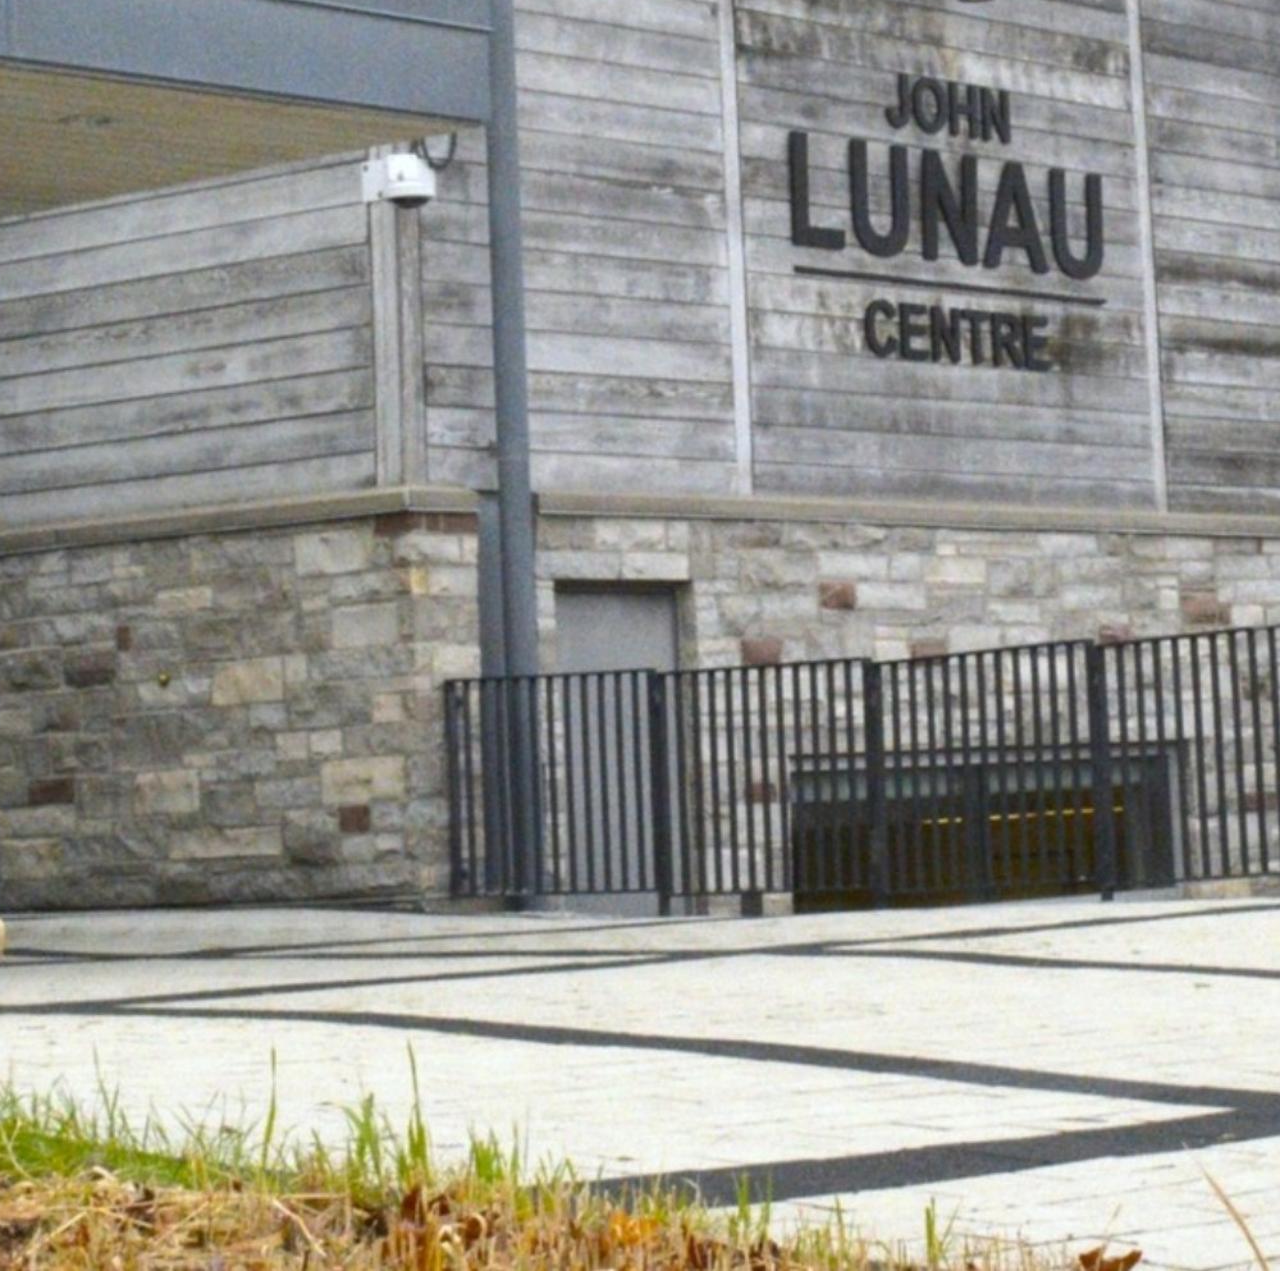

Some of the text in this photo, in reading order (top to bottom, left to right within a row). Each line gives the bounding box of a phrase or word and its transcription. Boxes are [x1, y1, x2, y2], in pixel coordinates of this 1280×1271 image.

[884, 73, 1011, 144] JOHN
[788, 131, 1105, 280] LUNAU
[864, 299, 1053, 371] CENTRE
